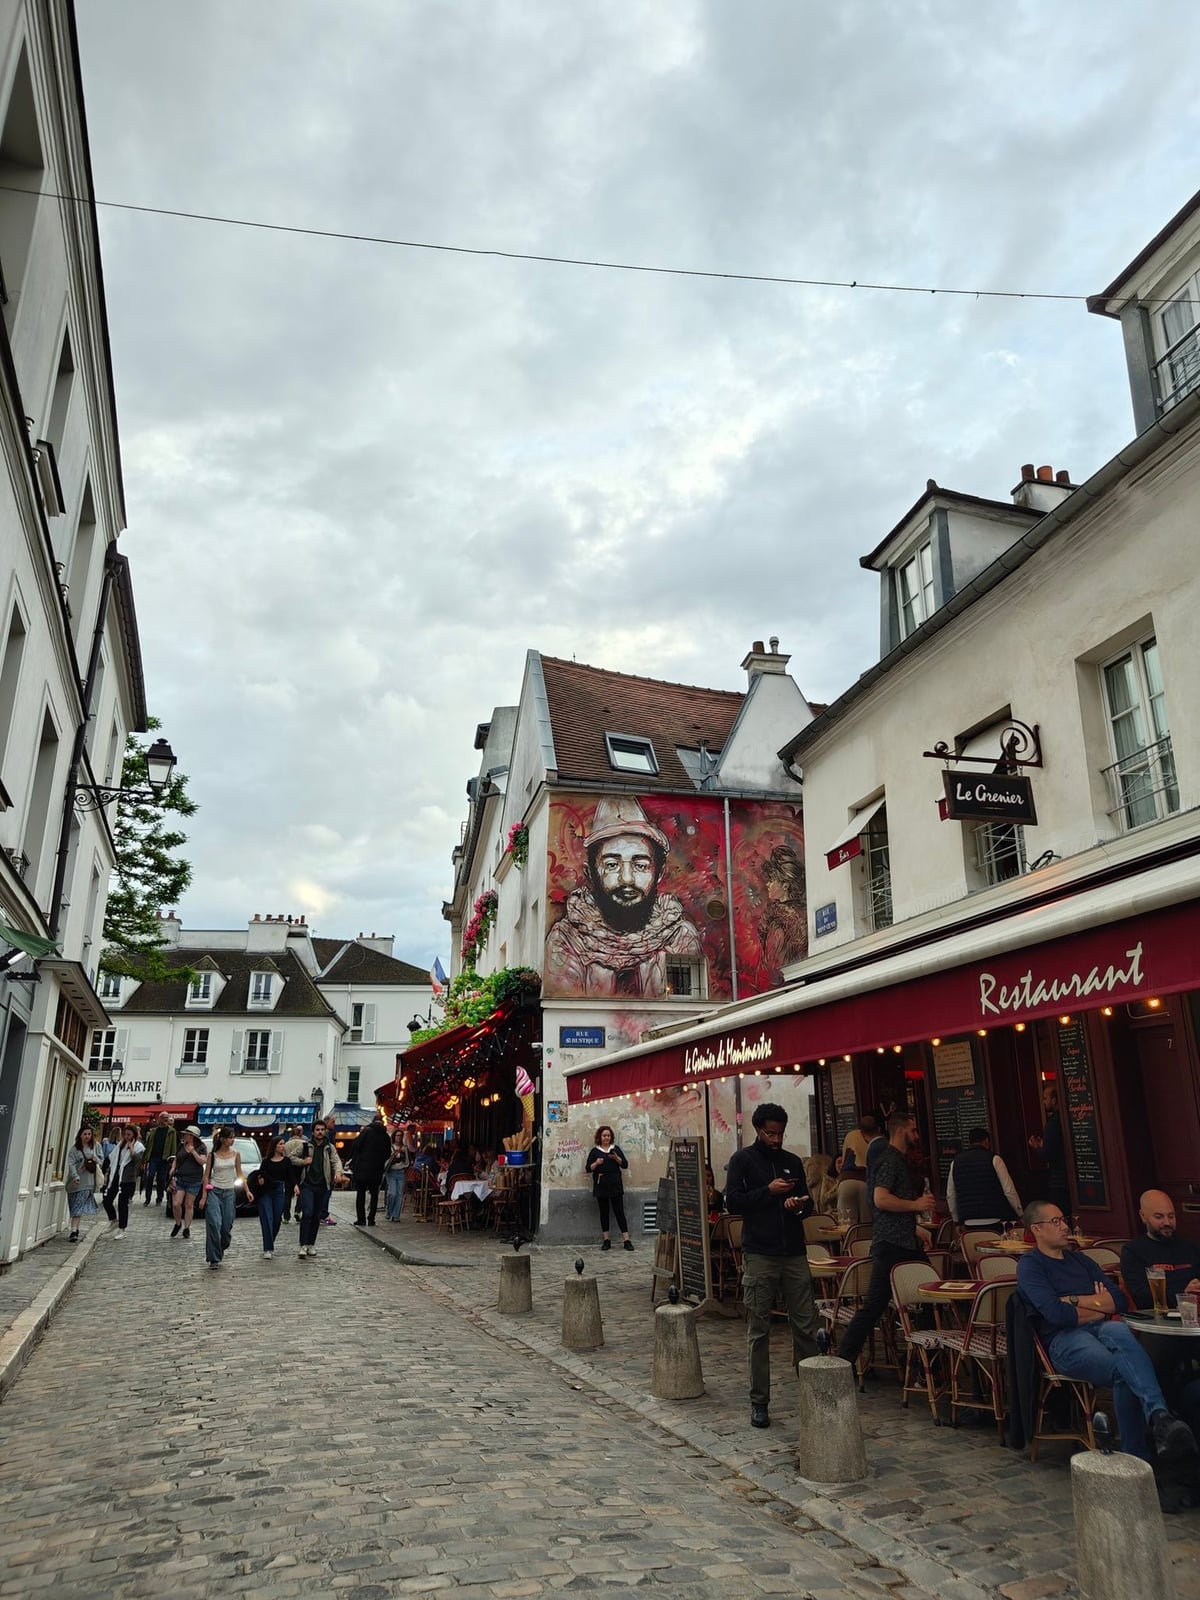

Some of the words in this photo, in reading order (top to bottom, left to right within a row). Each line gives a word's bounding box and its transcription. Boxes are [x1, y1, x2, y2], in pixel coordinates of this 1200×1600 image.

[956, 782, 973, 801] Le
[975, 784, 1025, 805] Grenier
[979, 941, 1144, 1015] Restaurant
[685, 1049, 692, 1075] Le
[692, 1047, 716, 1075] Grenier
[717, 1039, 725, 1068] de
[726, 1032, 773, 1065] Montmartre
[1167, 1038, 1172, 1049] 7
[88, 1081, 162, 1092] MONMARTRE
[581, 1078, 592, 1098] Bar
